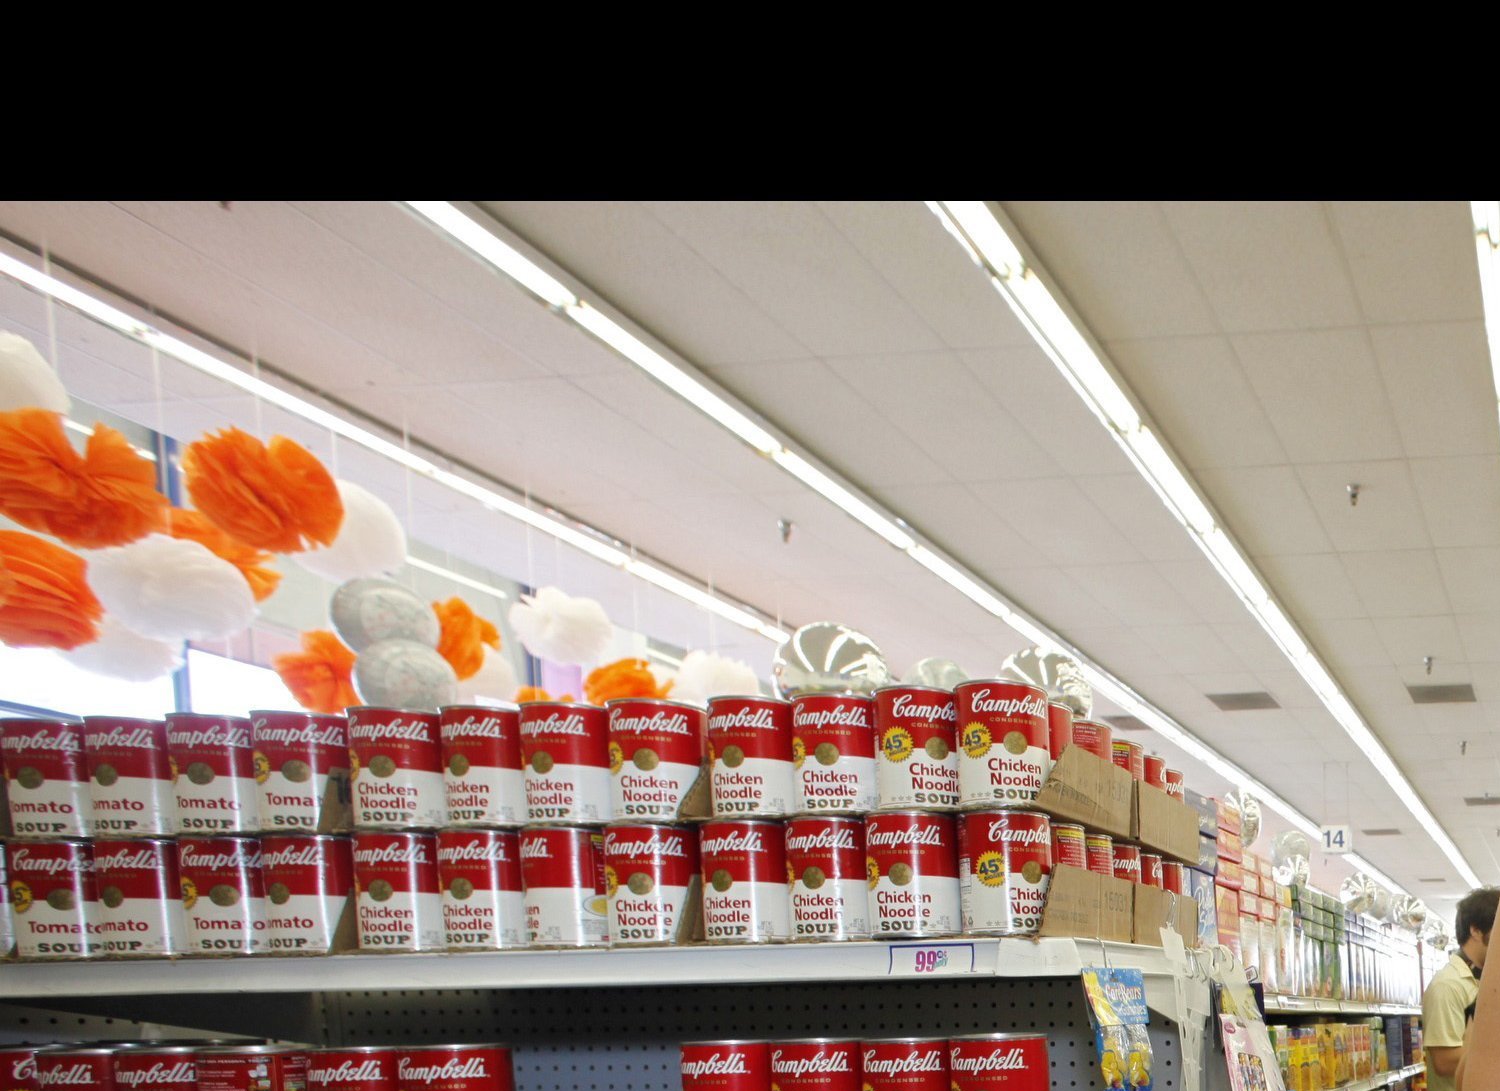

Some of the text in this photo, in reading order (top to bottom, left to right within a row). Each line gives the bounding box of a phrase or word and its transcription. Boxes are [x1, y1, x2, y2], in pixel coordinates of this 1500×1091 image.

[972, 689, 1048, 719] Campbell's
[793, 703, 871, 728] Campbell's
[610, 708, 692, 736] Campbell's
[253, 718, 347, 747] Campbell's
[988, 758, 1042, 775] Chicken
[620, 776, 678, 790] Chicken
[714, 774, 763, 785] Chicken
[803, 770, 858, 784] Chicken
[990, 773, 1041, 788] Noodle
[358, 783, 418, 797] Chicken
[623, 790, 677, 802] Noodle
[715, 787, 762, 799] Noodle
[804, 784, 857, 796] Noodle
[994, 789, 1040, 800] SOUP
[360, 797, 417, 810] Noodle
[807, 799, 855, 809] SOUP
[915, 792, 960, 805] SOUP
[625, 805, 674, 815] SOUP
[717, 801, 760, 812] SOUP
[363, 811, 413, 822] SOUP
[528, 808, 570, 818] SOUP
[16, 822, 67, 832] SOUP
[183, 818, 234, 829] SOUP
[867, 822, 945, 846] Campbell's
[1323, 830, 1345, 848] 14
[793, 894, 844, 906] Chicken
[877, 891, 932, 903] Chicken
[360, 906, 413, 918] Chicken
[706, 911, 750, 922] Noodle
[362, 920, 413, 932] Noodle
[708, 925, 747, 936] SOUP
[797, 923, 838, 934] SOUP
[364, 935, 411, 945] SOUP
[446, 933, 490, 943] SOUP
[915, 950, 936, 972] 99
[772, 1050, 852, 1077] Campbell's
[864, 1050, 945, 1077] Campbell's
[951, 1048, 1029, 1074] Campbell's
